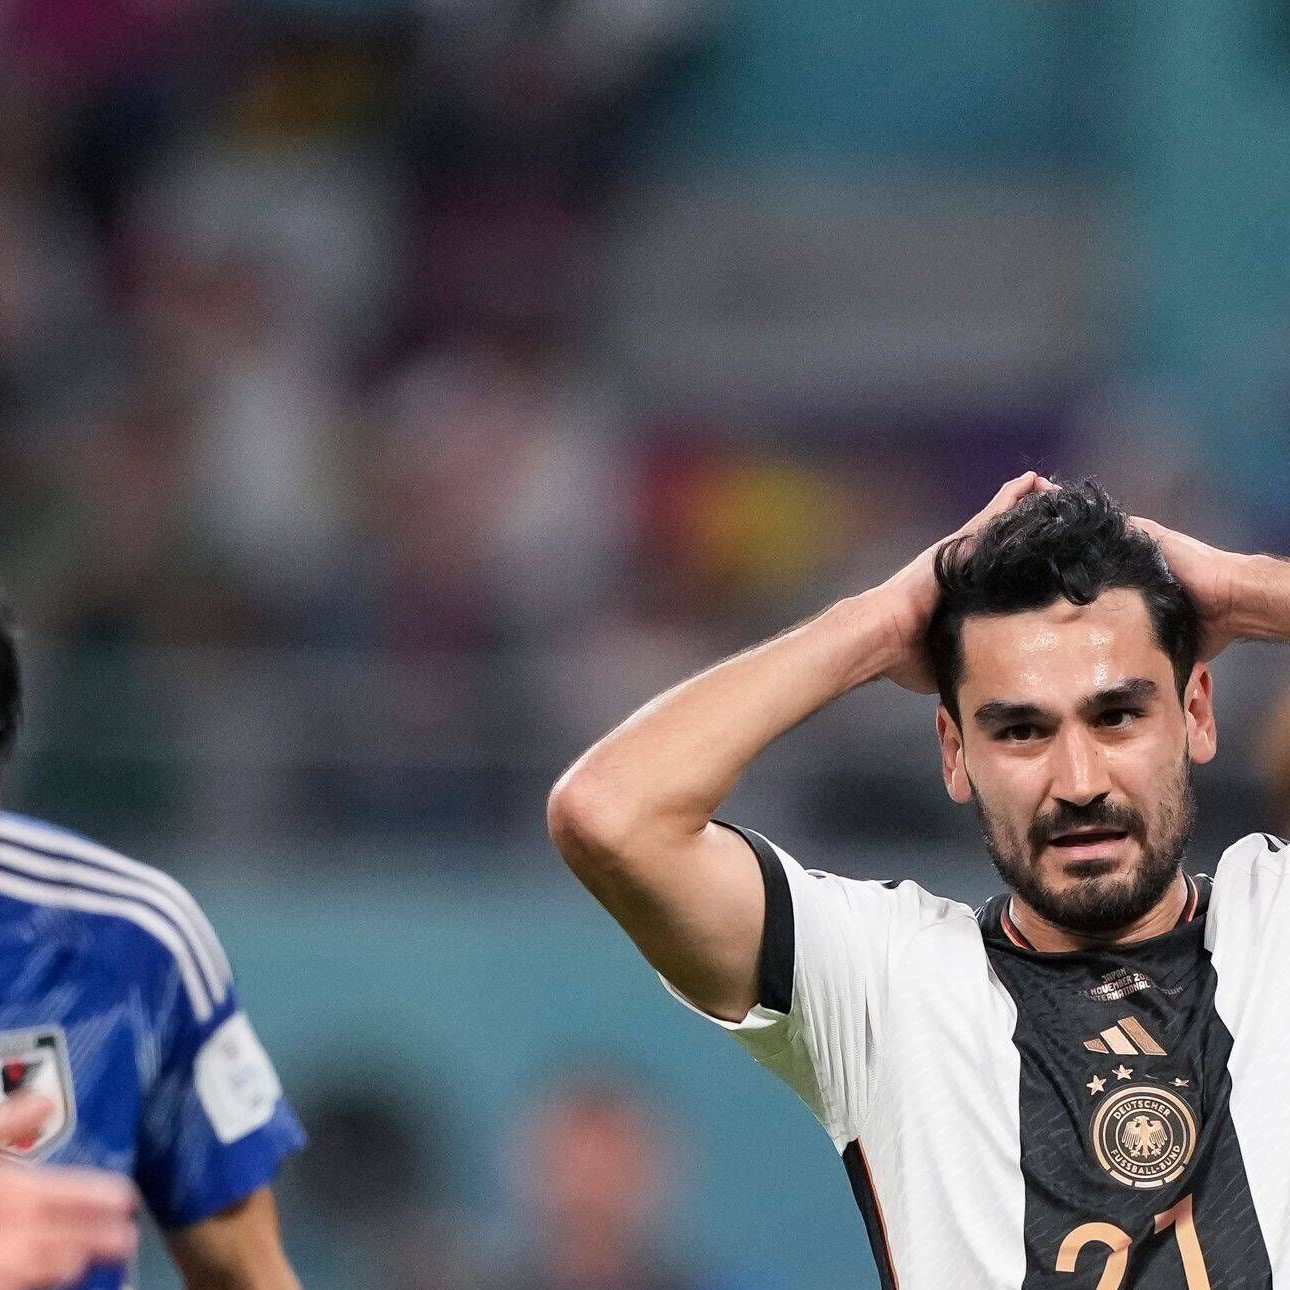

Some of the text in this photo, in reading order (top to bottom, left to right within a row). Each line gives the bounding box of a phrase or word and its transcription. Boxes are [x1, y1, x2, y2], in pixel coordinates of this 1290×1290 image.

[1090, 975, 1133, 996] NOVEMBER
[1101, 967, 1127, 984] JAPAN
[1113, 1100, 1171, 1120] DEUTSCHER
[1110, 1145, 1181, 1175] FUSSBALL-BUND
